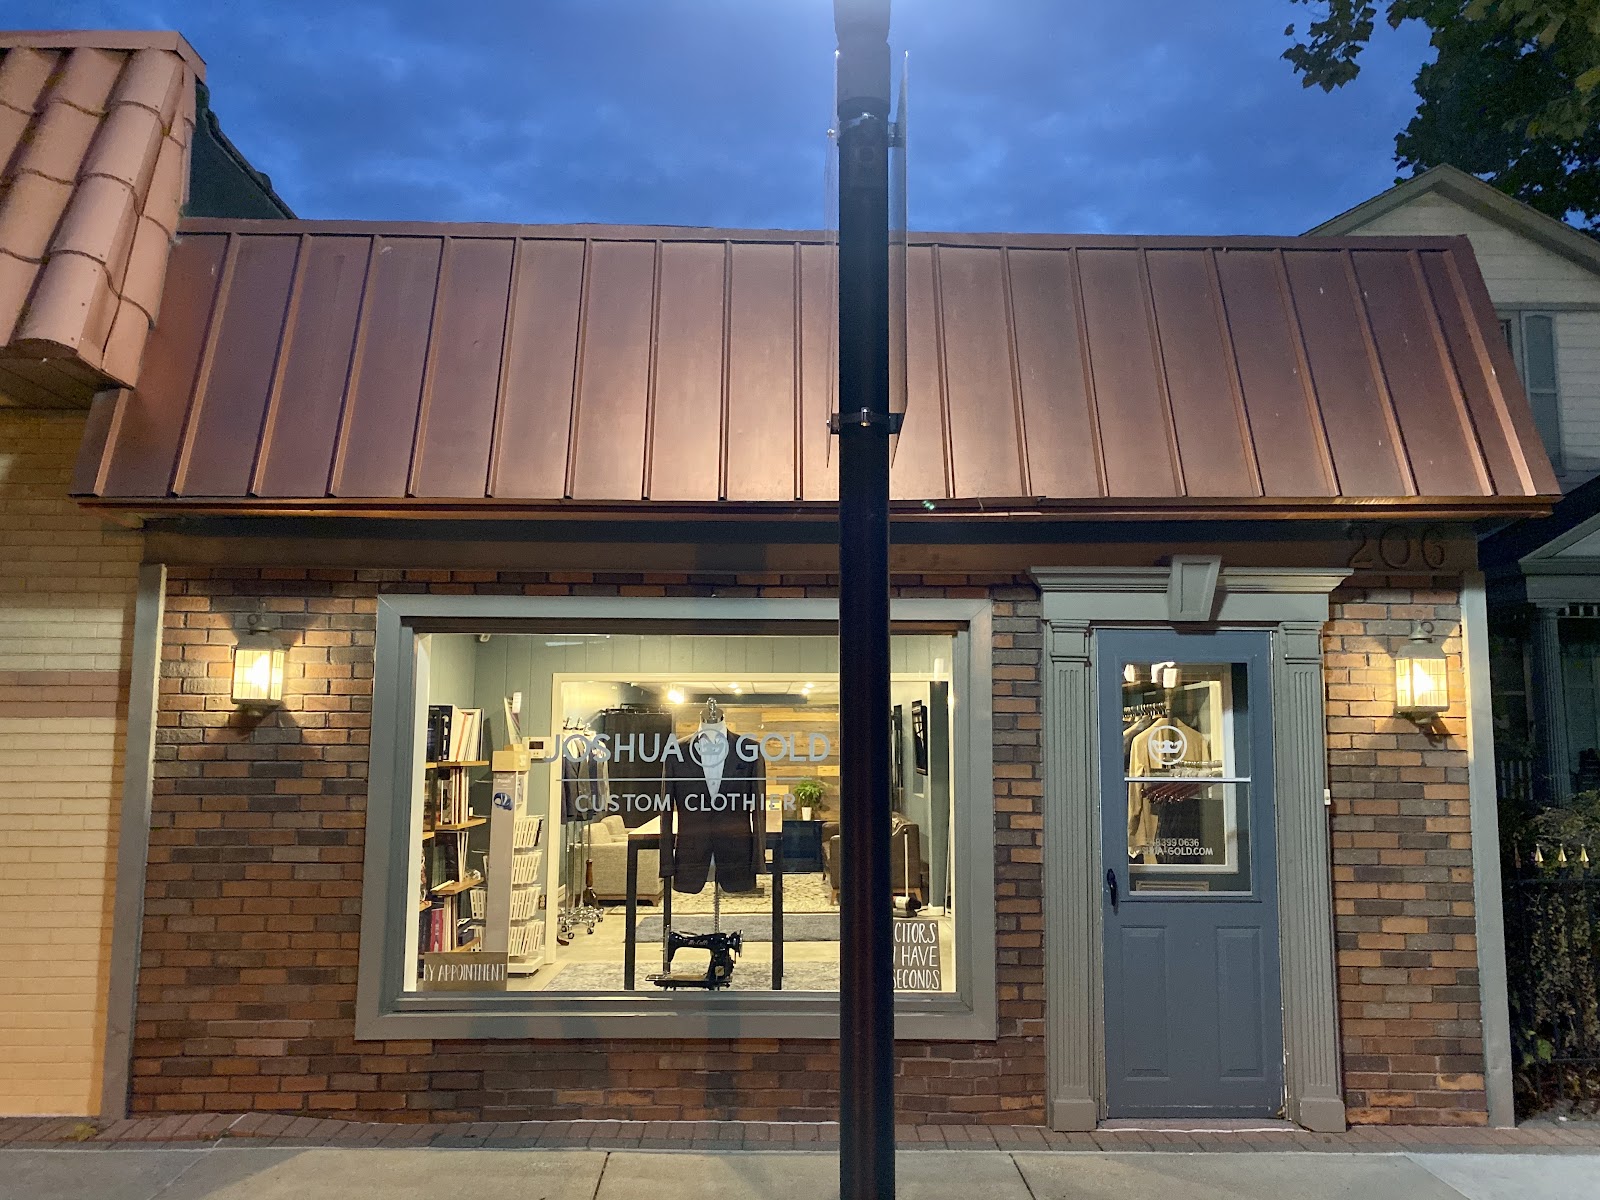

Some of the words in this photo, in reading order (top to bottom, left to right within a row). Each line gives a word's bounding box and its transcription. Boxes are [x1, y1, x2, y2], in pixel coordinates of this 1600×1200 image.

[1347, 523, 1445, 570] 206
[543, 733, 685, 763] JOSHUA
[735, 732, 831, 763] GOLD
[574, 793, 671, 812] CUSTOM
[684, 792, 797, 812] CLOTHIER
[893, 922, 937, 943] CITORS
[901, 946, 938, 967] HAVE
[423, 964, 436, 981] BY
[437, 963, 507, 981] APPOINTMENT
